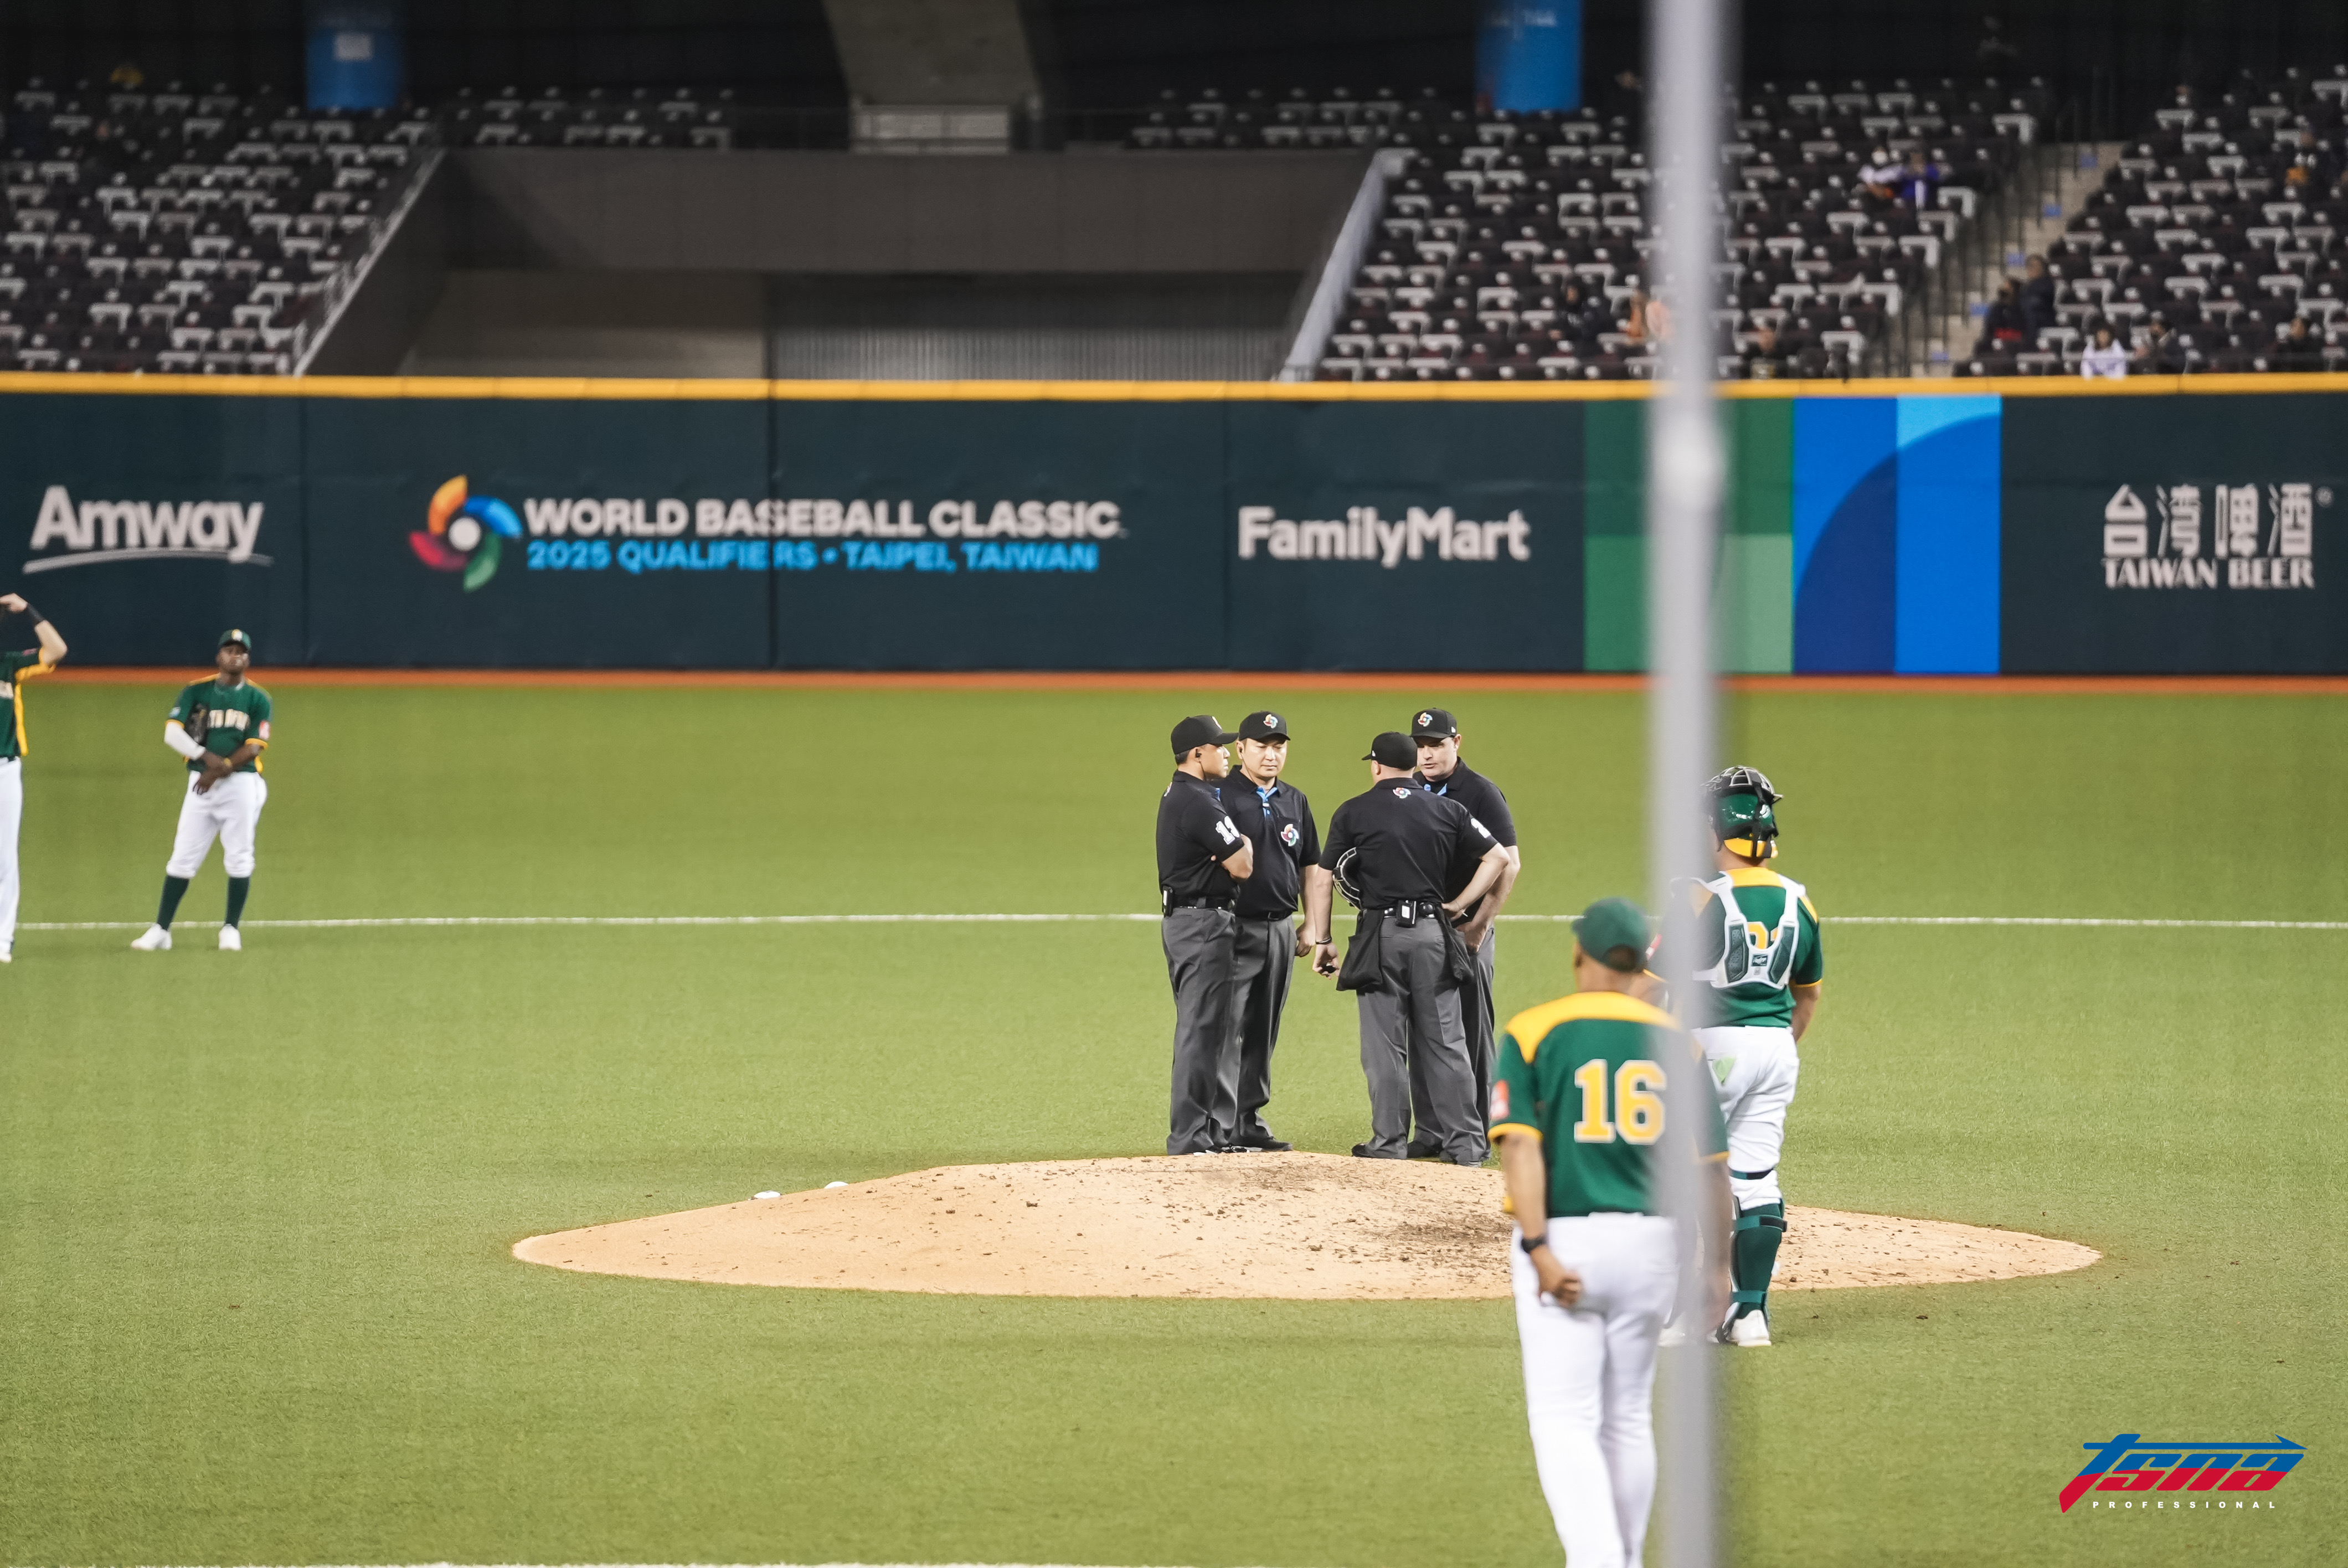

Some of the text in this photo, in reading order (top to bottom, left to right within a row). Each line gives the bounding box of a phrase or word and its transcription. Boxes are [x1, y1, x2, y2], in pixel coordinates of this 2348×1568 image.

[29, 485, 265, 564] Amway
[523, 498, 1121, 538] WORLD BASEBALL CLASSIC
[1238, 506, 1531, 569] FamilyMart
[527, 540, 612, 570] 2025
[616, 540, 818, 575] QUALIFIERS
[961, 542, 1099, 571] TAIWAN
[2103, 558, 2315, 589] TAIWAN BEER
[1574, 1059, 1667, 1145] 16
